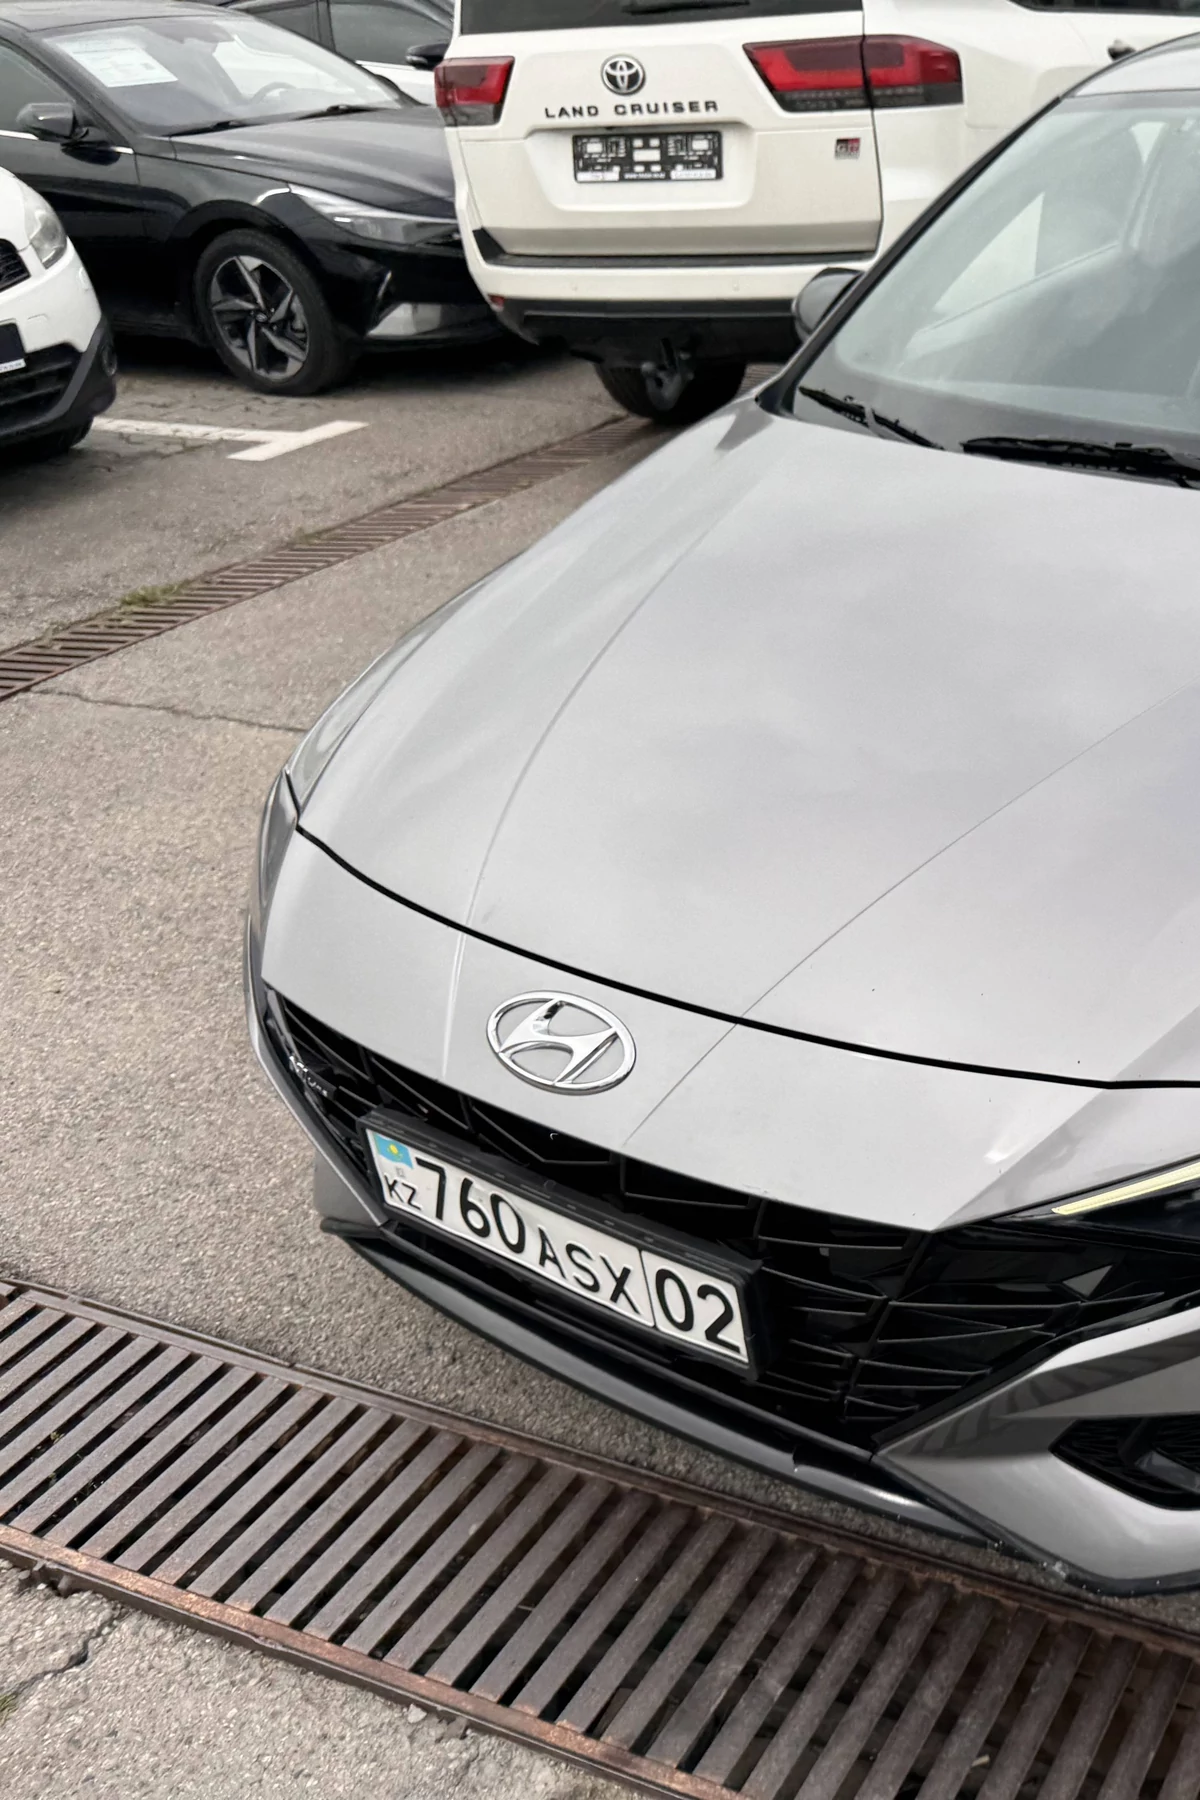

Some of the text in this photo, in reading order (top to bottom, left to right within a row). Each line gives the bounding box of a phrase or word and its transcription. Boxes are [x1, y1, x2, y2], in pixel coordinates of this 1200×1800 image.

[545, 100, 718, 119] LAND CRUISER
[384, 1174, 422, 1211] KZ
[415, 1156, 741, 1354] 760 ASX 02
